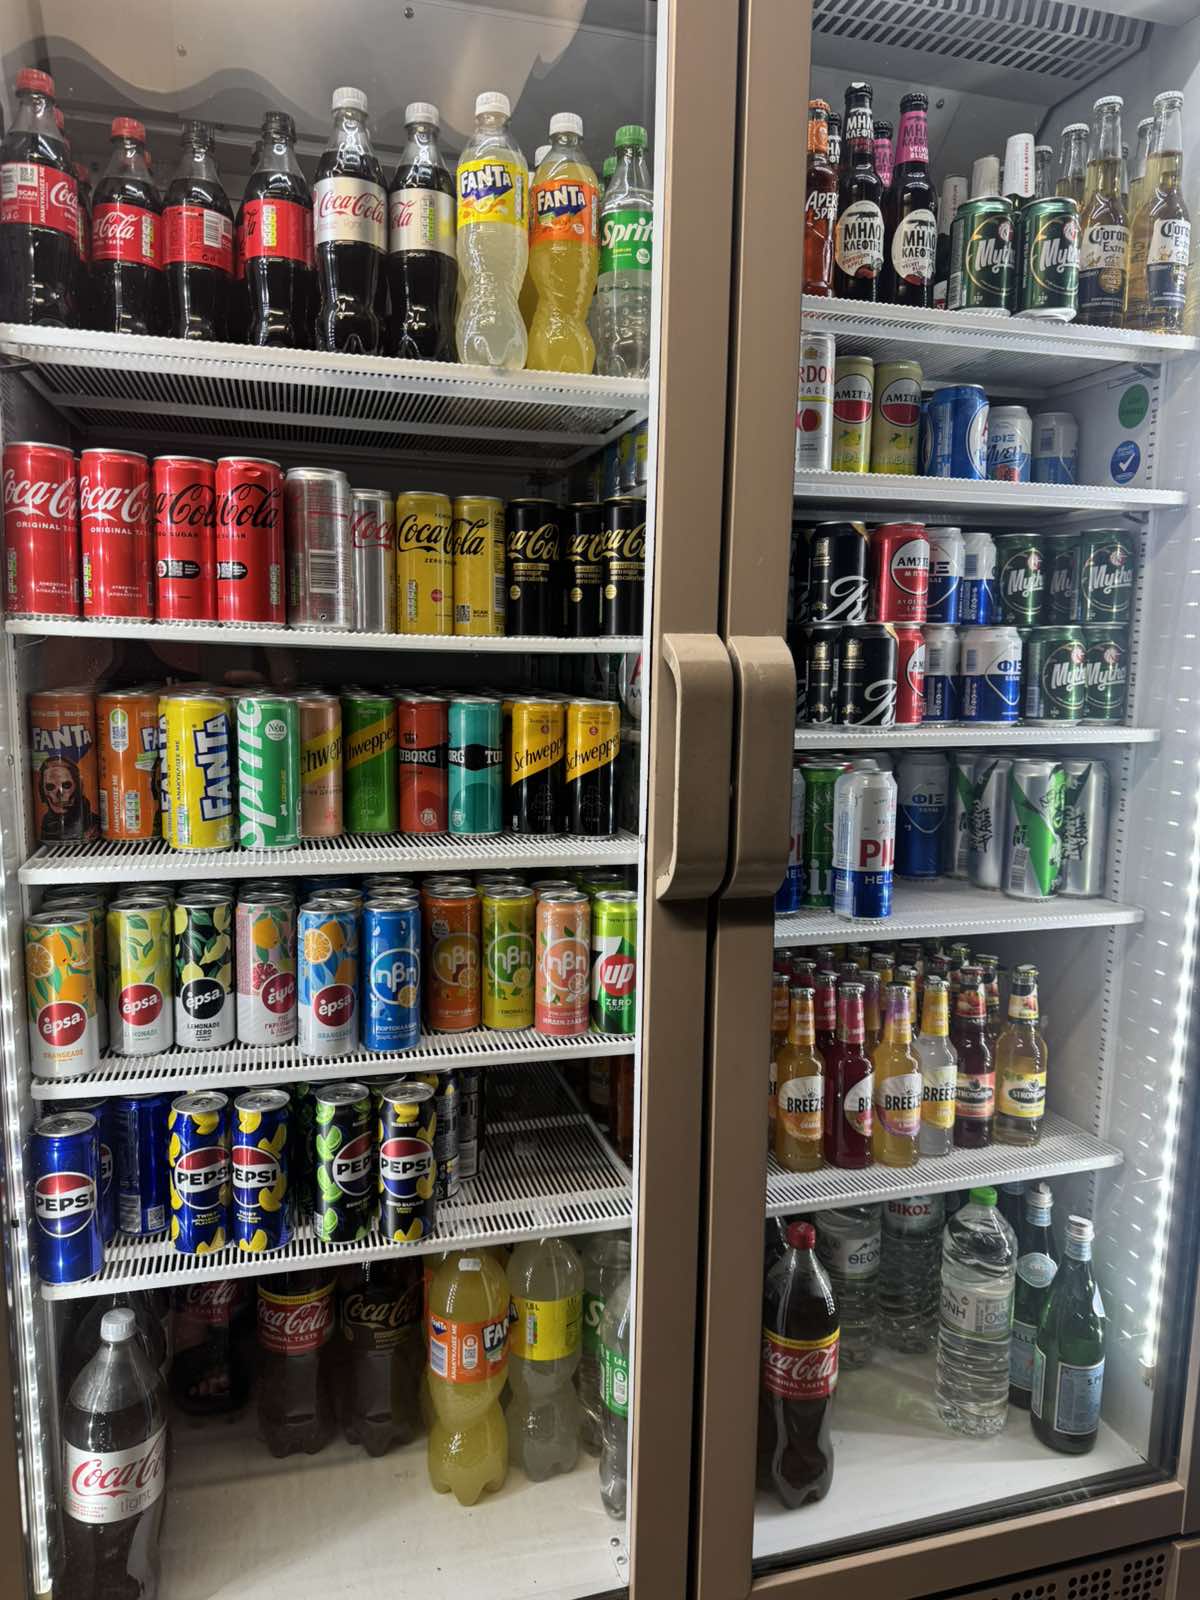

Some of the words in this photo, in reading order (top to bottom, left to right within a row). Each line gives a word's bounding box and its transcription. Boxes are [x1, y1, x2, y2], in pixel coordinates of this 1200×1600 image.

[461, 165, 512, 194] FANTA
[319, 191, 386, 225] Coca-Cola
[537, 186, 586, 213] FANTA
[602, 217, 653, 249] Sprit
[16, 521, 60, 532] ORIGINAL
[90, 526, 132, 536] ORIGINAL
[33, 725, 93, 750] FANTA
[194, 714, 233, 821] FANTA
[605, 999, 632, 1007] ZERO
[187, 1021, 220, 1030] LEMONADE
[381, 1156, 432, 1174] PEPSI
